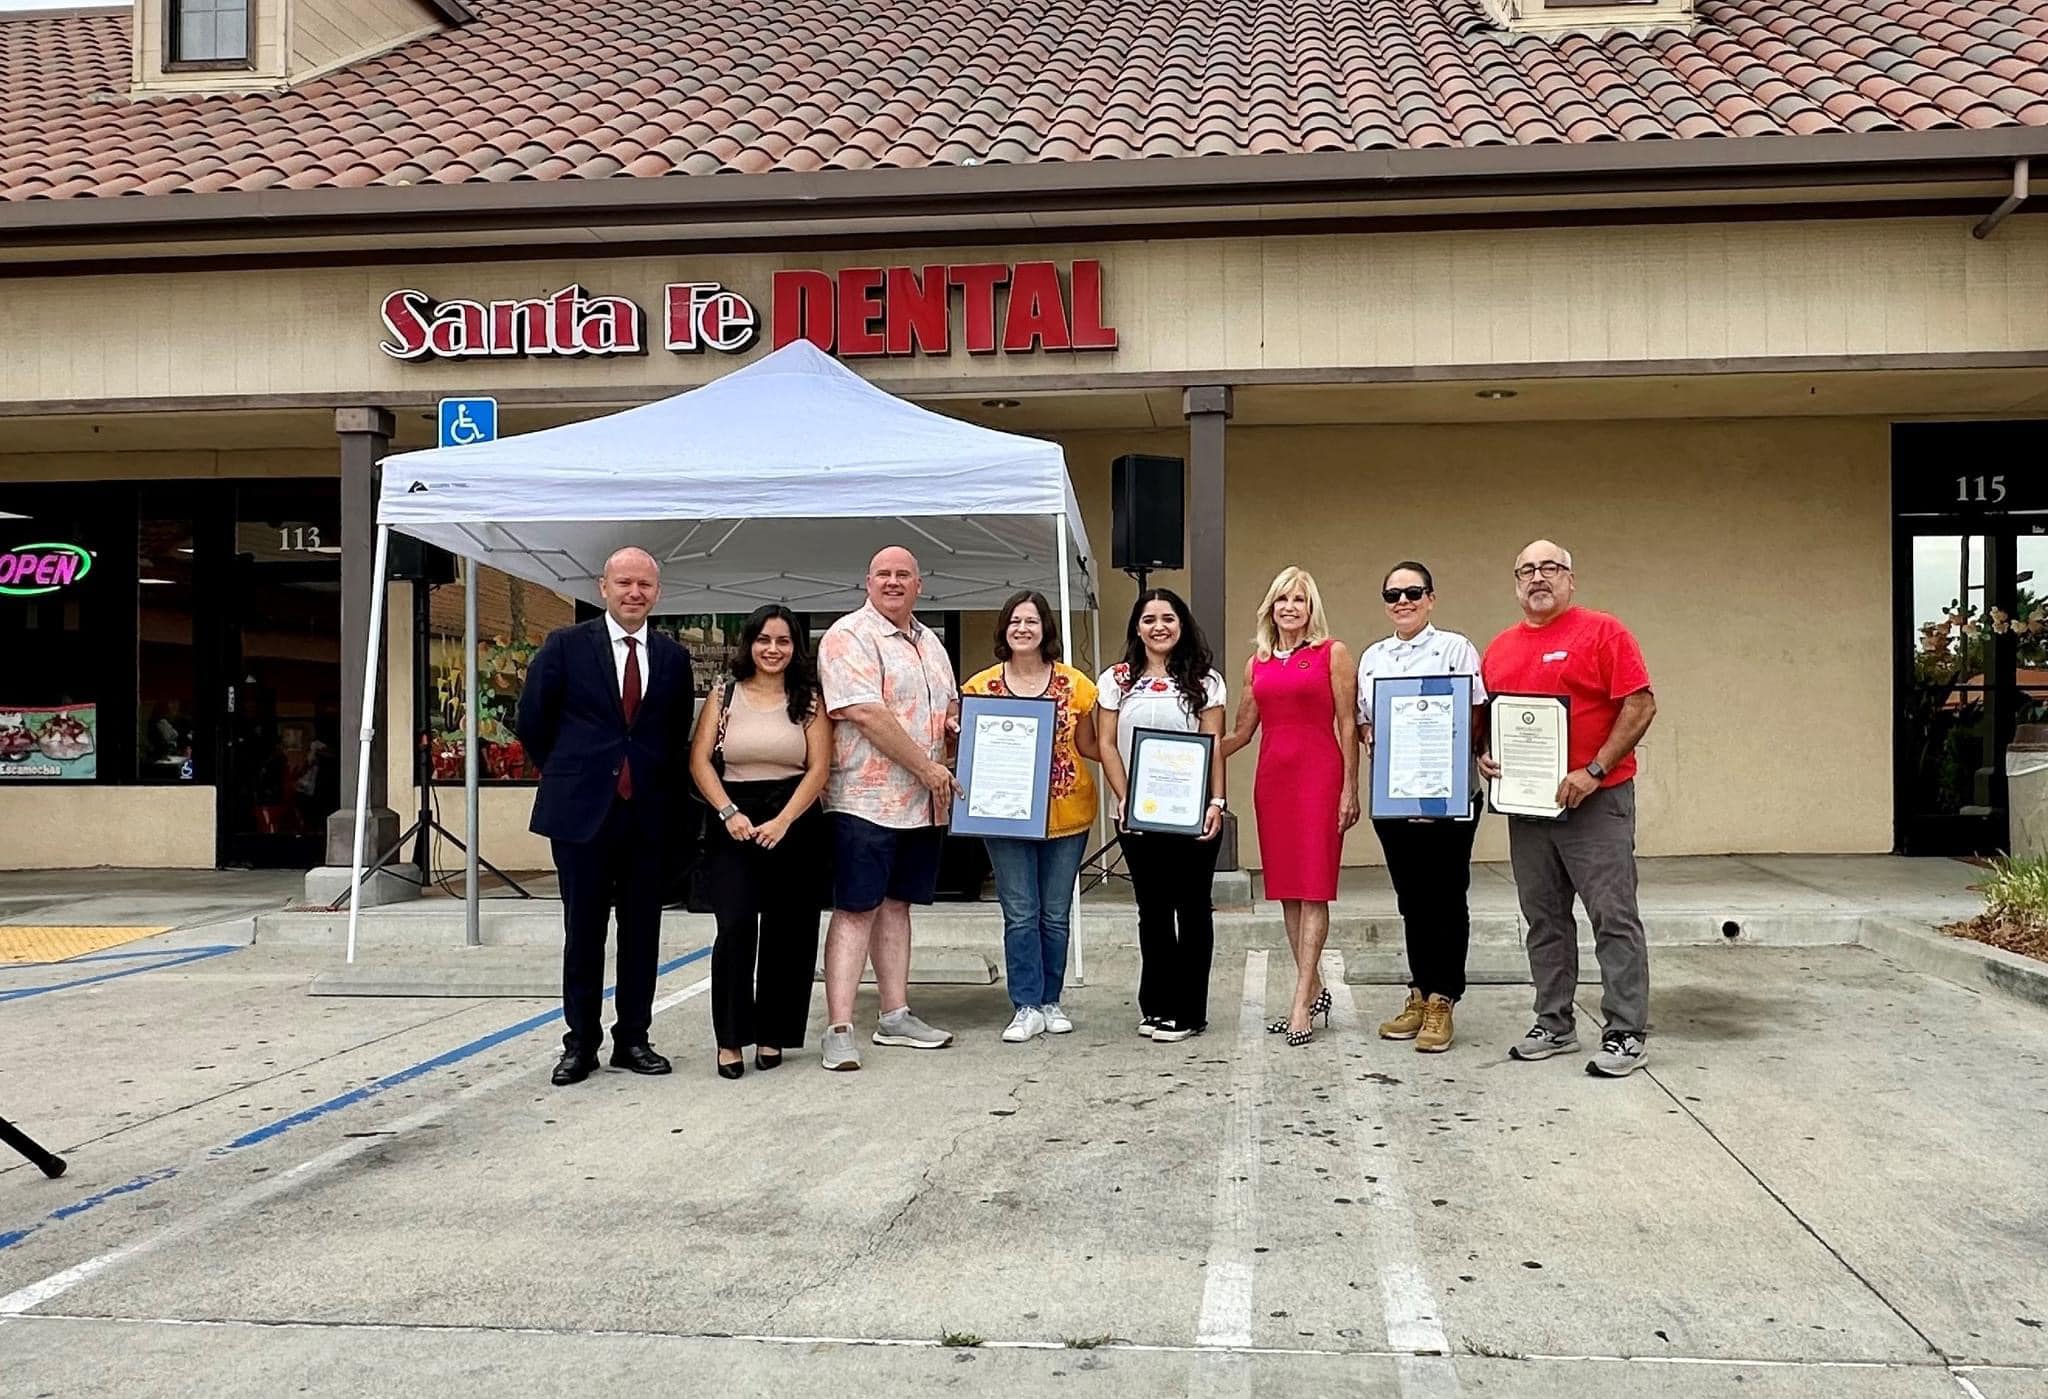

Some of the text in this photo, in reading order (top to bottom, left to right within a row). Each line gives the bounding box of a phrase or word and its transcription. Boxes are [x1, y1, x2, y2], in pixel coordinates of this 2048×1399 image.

[380, 260, 1118, 358] Santa Fe DENTAL
[1956, 475, 2006, 503] 115
[280, 527, 320, 552] 113
[0, 554, 79, 584] OPEN
